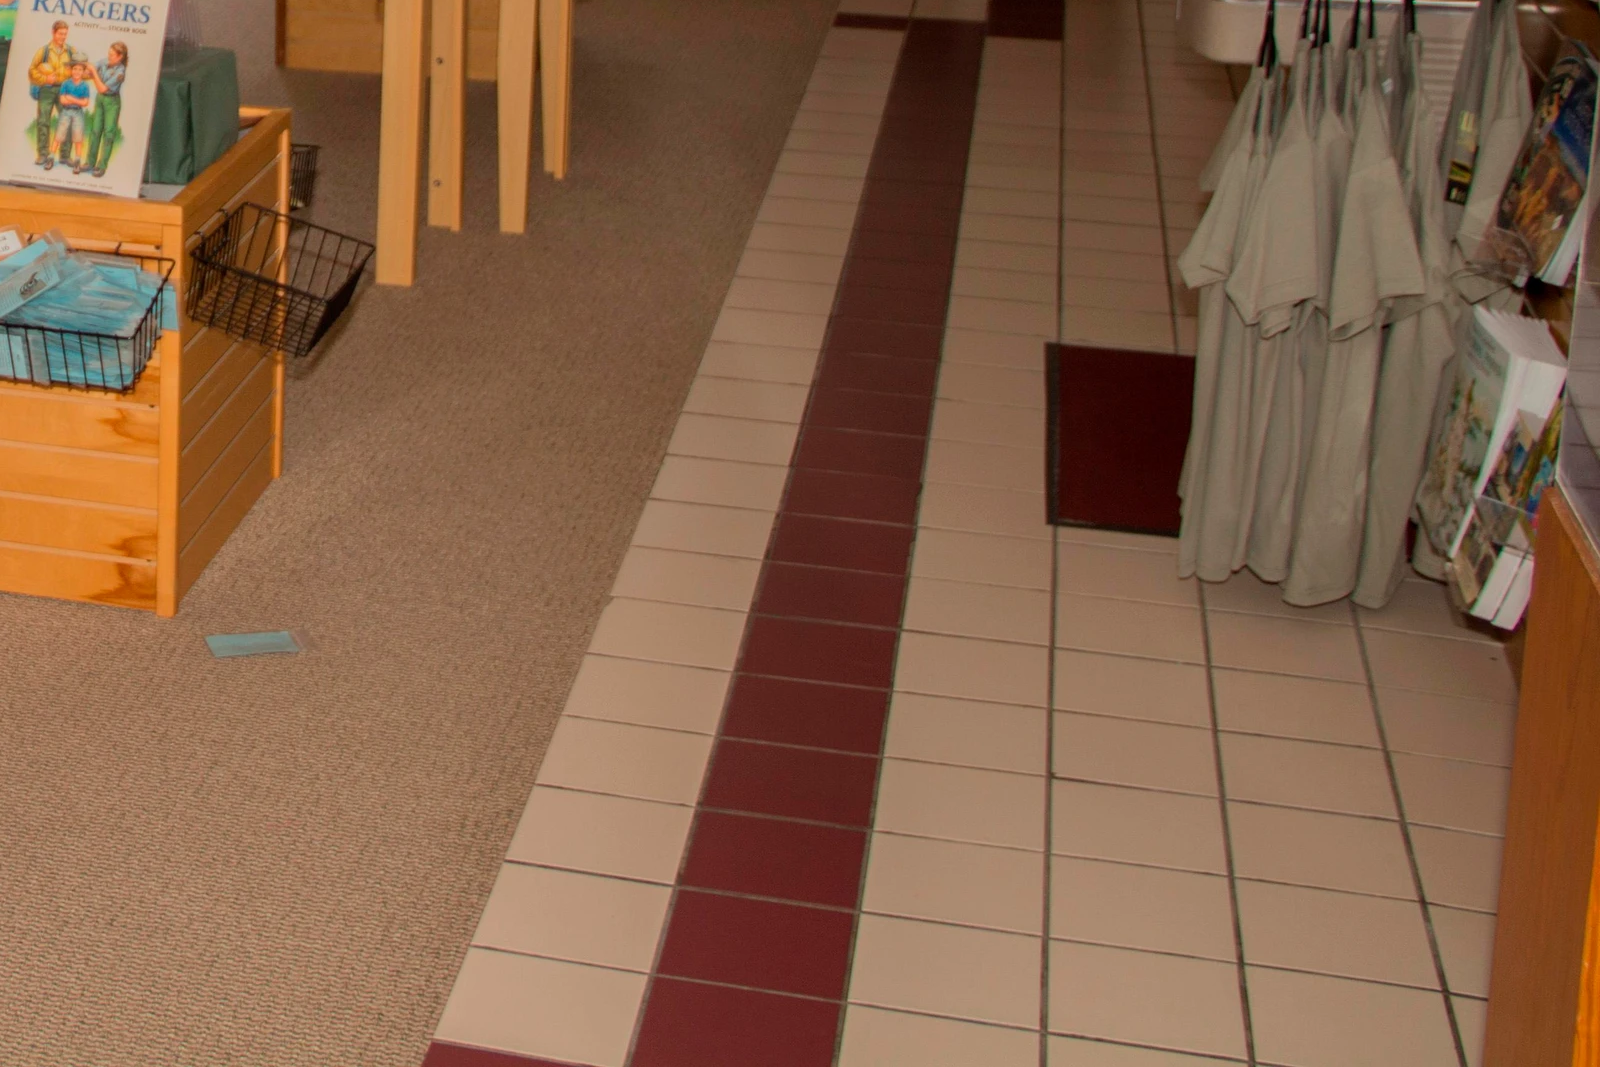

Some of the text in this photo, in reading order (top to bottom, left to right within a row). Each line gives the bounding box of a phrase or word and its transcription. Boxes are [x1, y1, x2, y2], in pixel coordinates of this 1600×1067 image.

[73, 21, 100, 31] ACTIVITY
[108, 25, 131, 33] STICKER
[131, 26, 148, 35] BOOK
